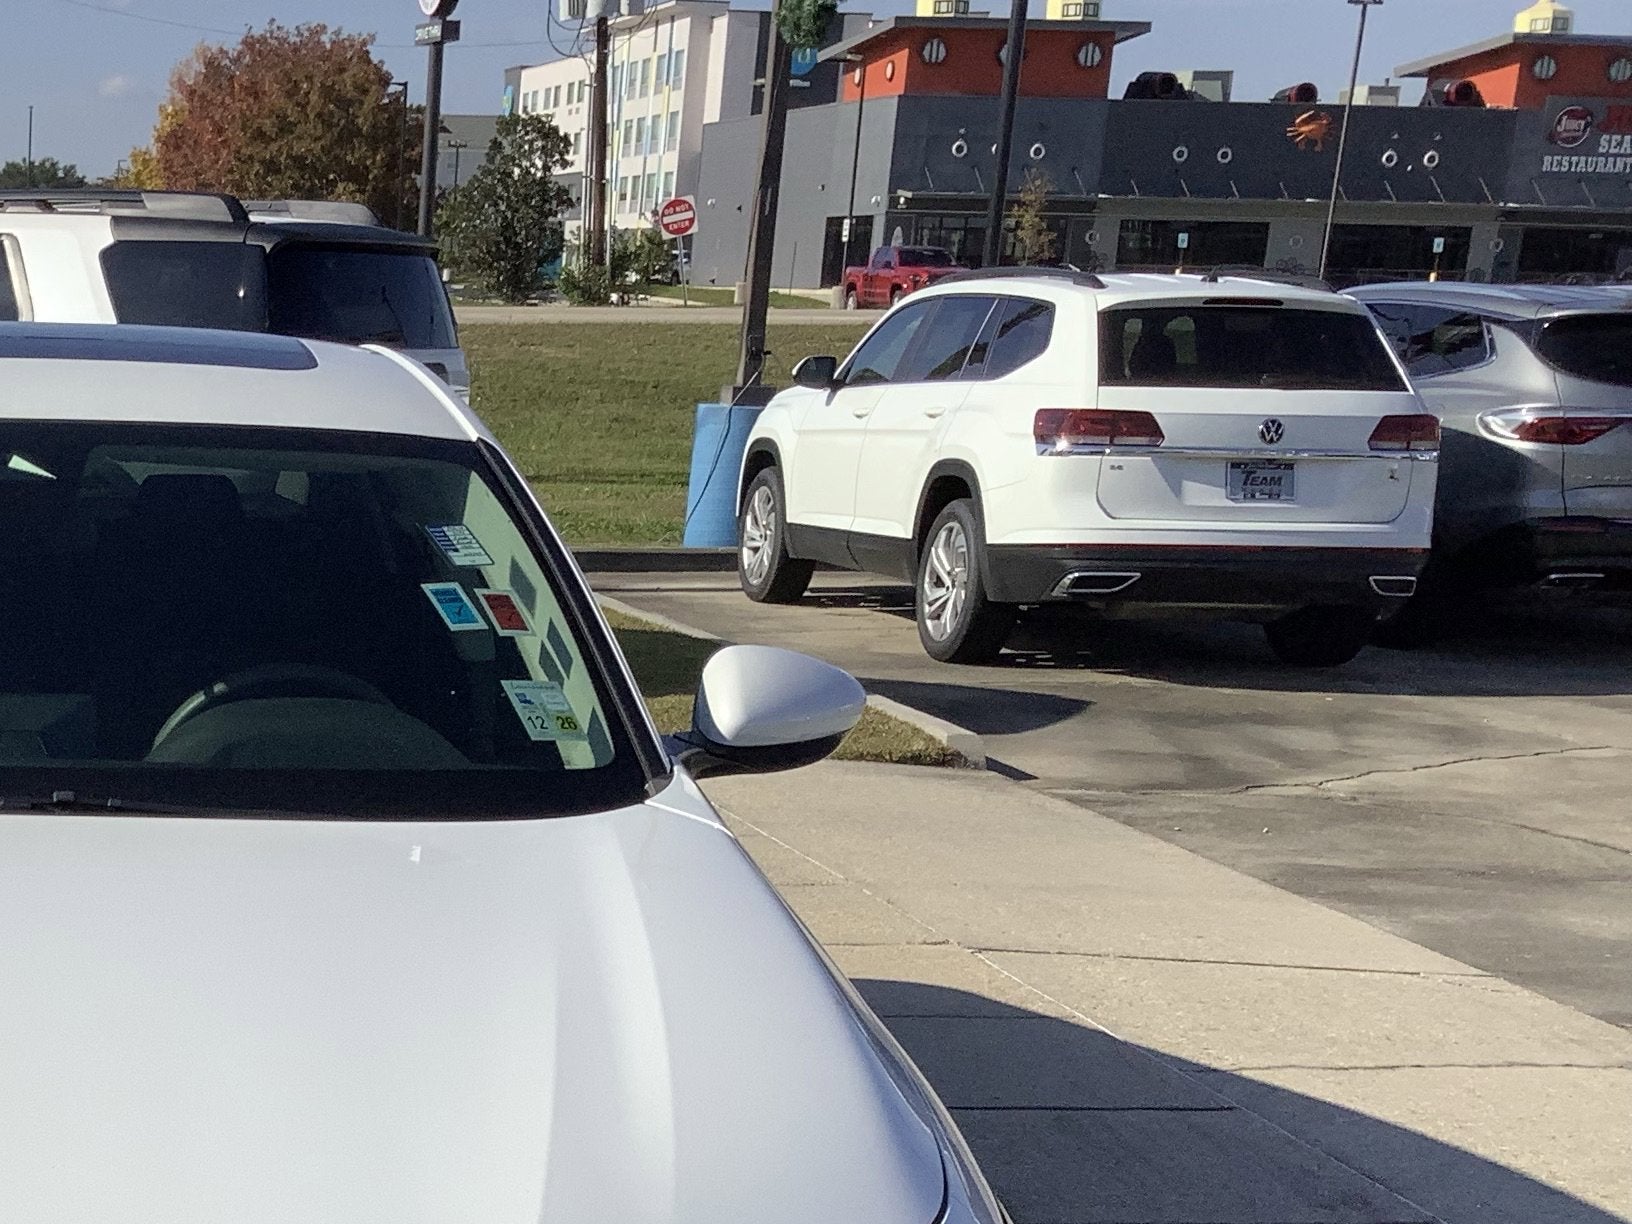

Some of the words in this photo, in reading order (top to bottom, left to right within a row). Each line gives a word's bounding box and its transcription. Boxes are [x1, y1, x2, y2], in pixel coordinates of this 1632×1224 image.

[1542, 155, 1632, 173] RESTAURANT
[1241, 470, 1282, 486] TEAM
[527, 716, 549, 729] 12
[556, 716, 578, 730] 26
